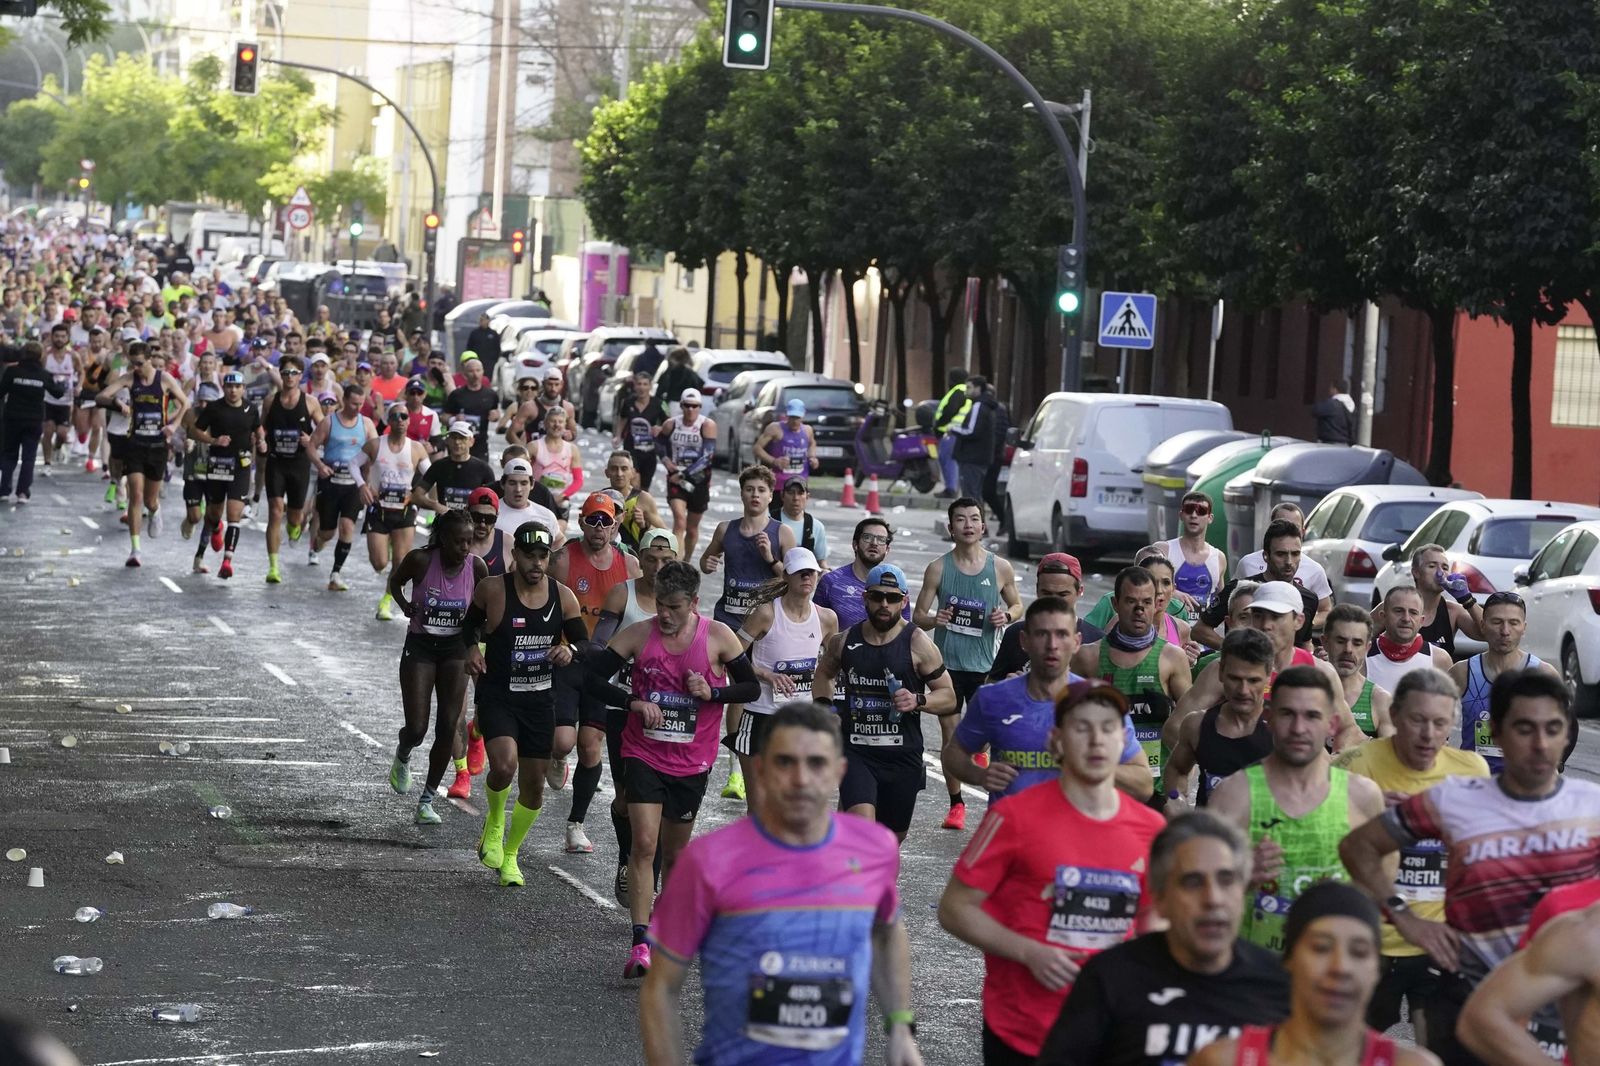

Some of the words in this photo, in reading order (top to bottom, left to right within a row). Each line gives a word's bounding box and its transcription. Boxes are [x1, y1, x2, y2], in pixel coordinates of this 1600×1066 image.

[726, 596, 740, 606] TOM
[428, 617, 458, 626] MAGALI
[955, 616, 971, 626] RYO
[527, 651, 546, 660] ZURIC
[789, 661, 812, 669] ZURICH
[529, 673, 552, 683] VILLEGAS
[663, 695, 694, 705] ZURICH
[854, 723, 899, 734] PORTILLO
[1136, 731, 1158, 740] URICH
[1463, 827, 1589, 865] JARANA
[1084, 873, 1133, 889] ZURICH
[788, 956, 846, 973] ZURICH
[778, 1003, 828, 1027] NICO
